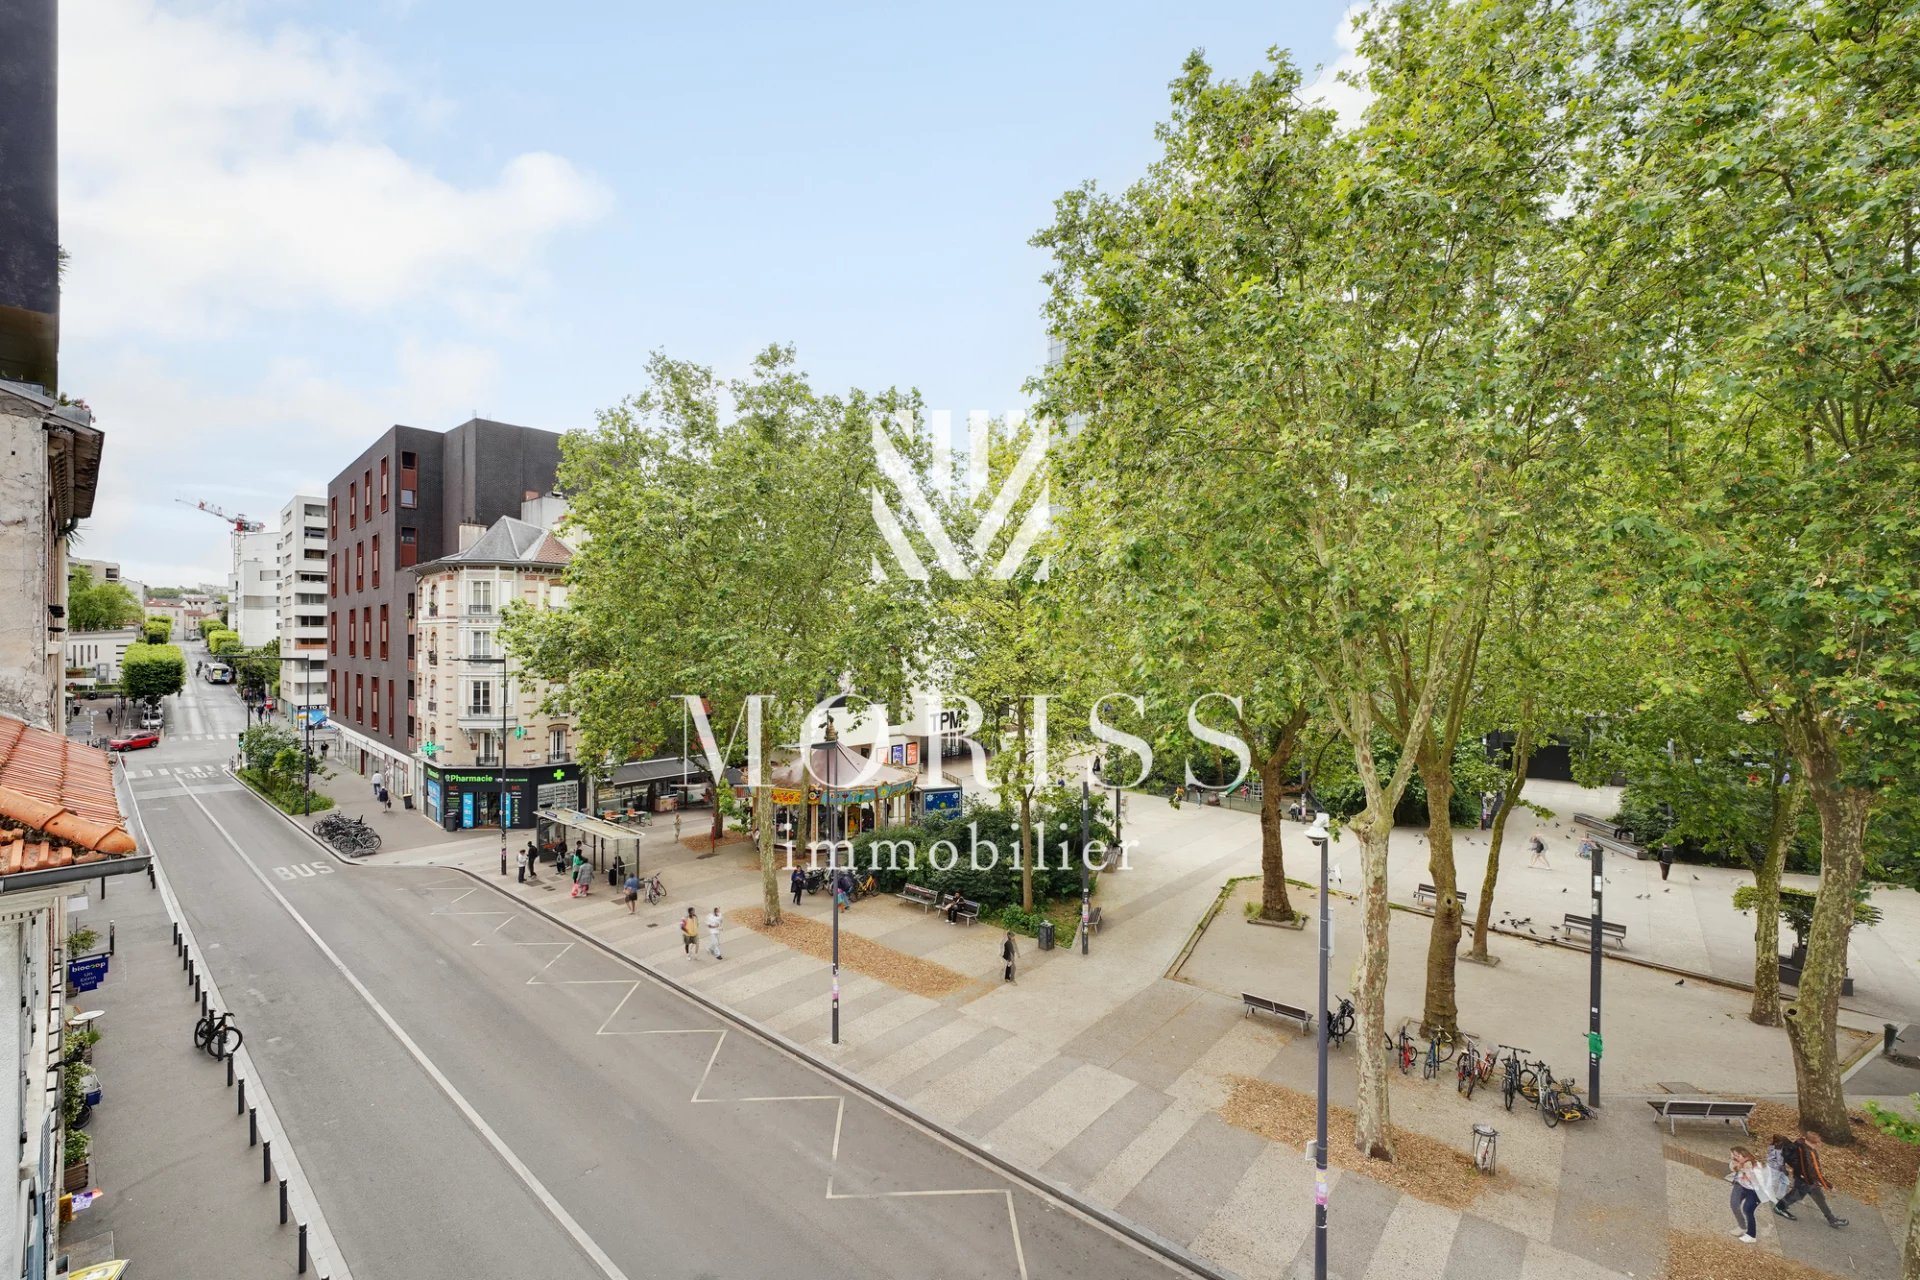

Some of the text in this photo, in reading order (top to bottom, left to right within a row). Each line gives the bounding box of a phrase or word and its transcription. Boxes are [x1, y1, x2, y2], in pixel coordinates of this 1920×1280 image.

[184, 771, 220, 780] BUS
[450, 774, 493, 782] Pharmacie
[271, 861, 335, 881] BUS
[72, 962, 106, 973] biocoop
